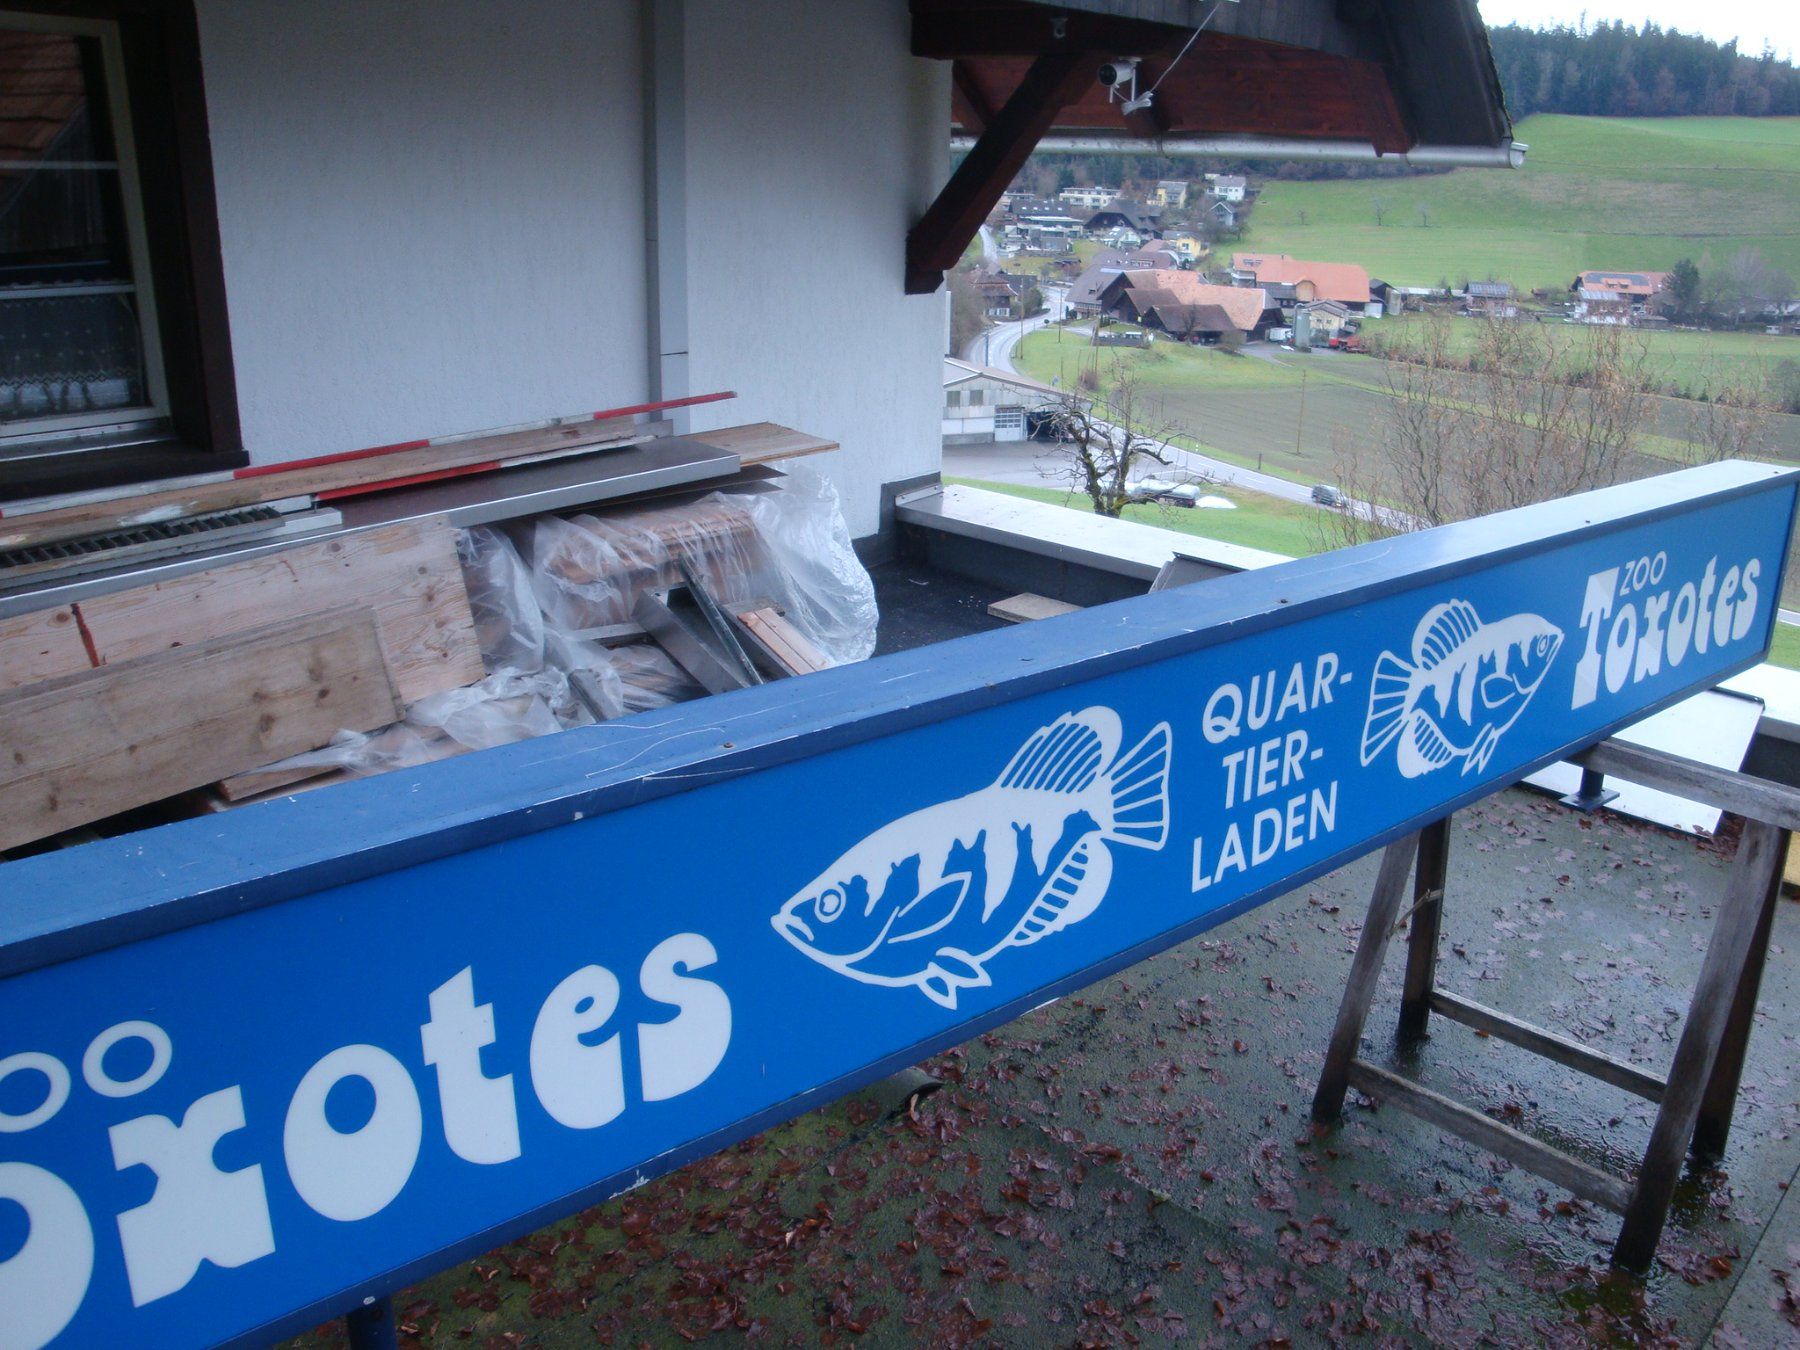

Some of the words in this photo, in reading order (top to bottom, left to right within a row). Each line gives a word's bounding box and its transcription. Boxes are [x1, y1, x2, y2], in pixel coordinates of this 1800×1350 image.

[1571, 555, 1761, 710] Toxotes
[1202, 651, 1353, 744] QUAR-
[1222, 729, 1324, 809] TIER-
[1191, 780, 1339, 894] LADEN
[0, 932, 732, 1350] oxotes
